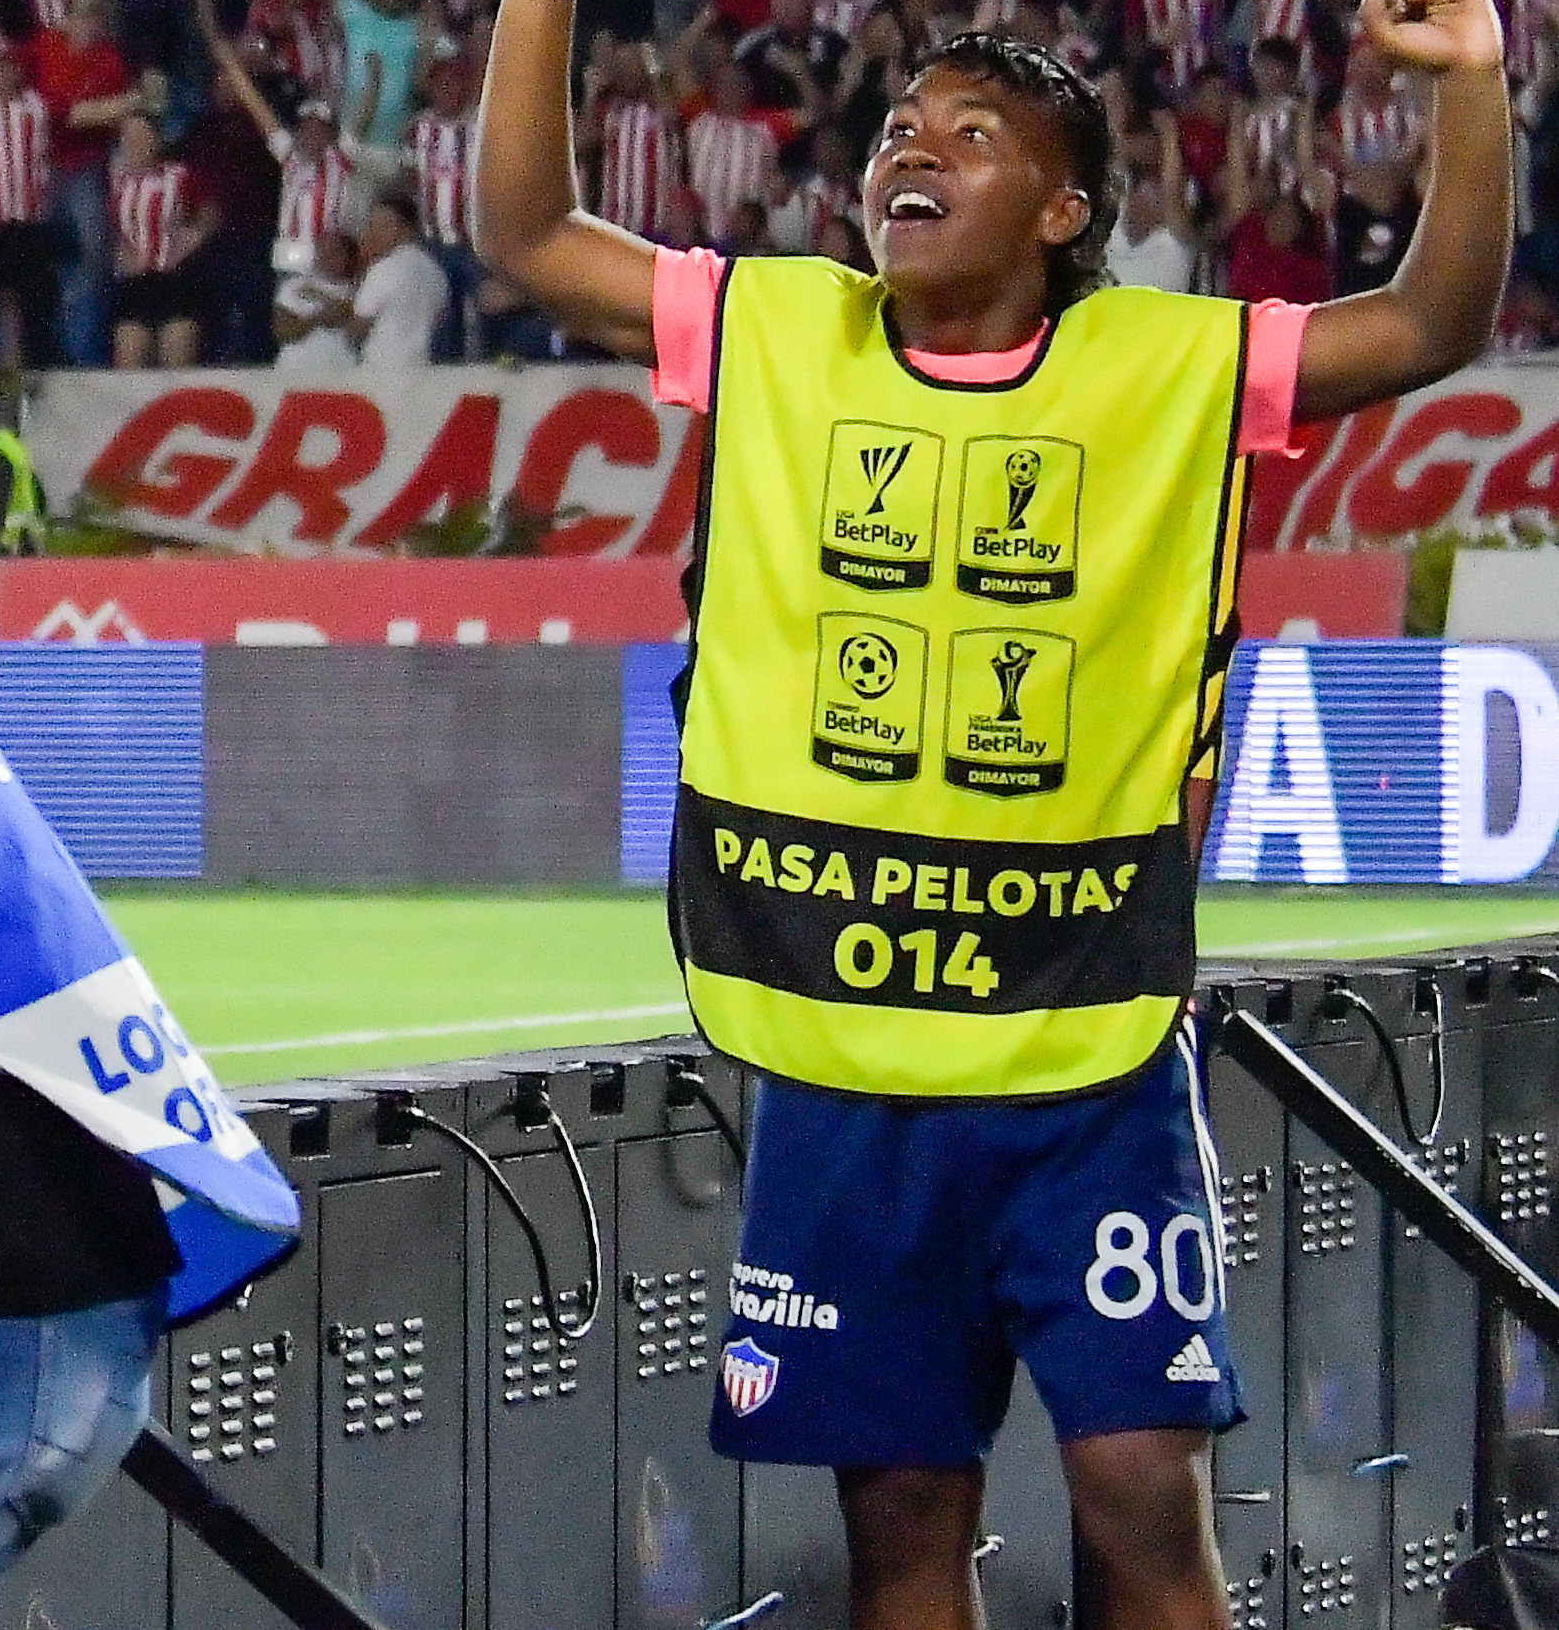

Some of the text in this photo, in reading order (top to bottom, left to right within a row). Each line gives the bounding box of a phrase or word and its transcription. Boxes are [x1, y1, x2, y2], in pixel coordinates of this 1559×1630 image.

[834, 518, 918, 553] BetPlay
[972, 535, 1061, 563] BetPlay
[839, 560, 906, 584] DIMAYOR
[980, 577, 1051, 595] DIMAYOR
[824, 710, 905, 746] BetPlay
[967, 733, 1047, 758] BetPlay
[831, 752, 894, 775] DIMAYOR
[968, 770, 1040, 787] DIMAYOR
[714, 827, 856, 902] PASA
[871, 856, 1139, 918] PELOTAS
[833, 921, 1000, 998] 014
[1085, 1211, 1215, 1322] 80
